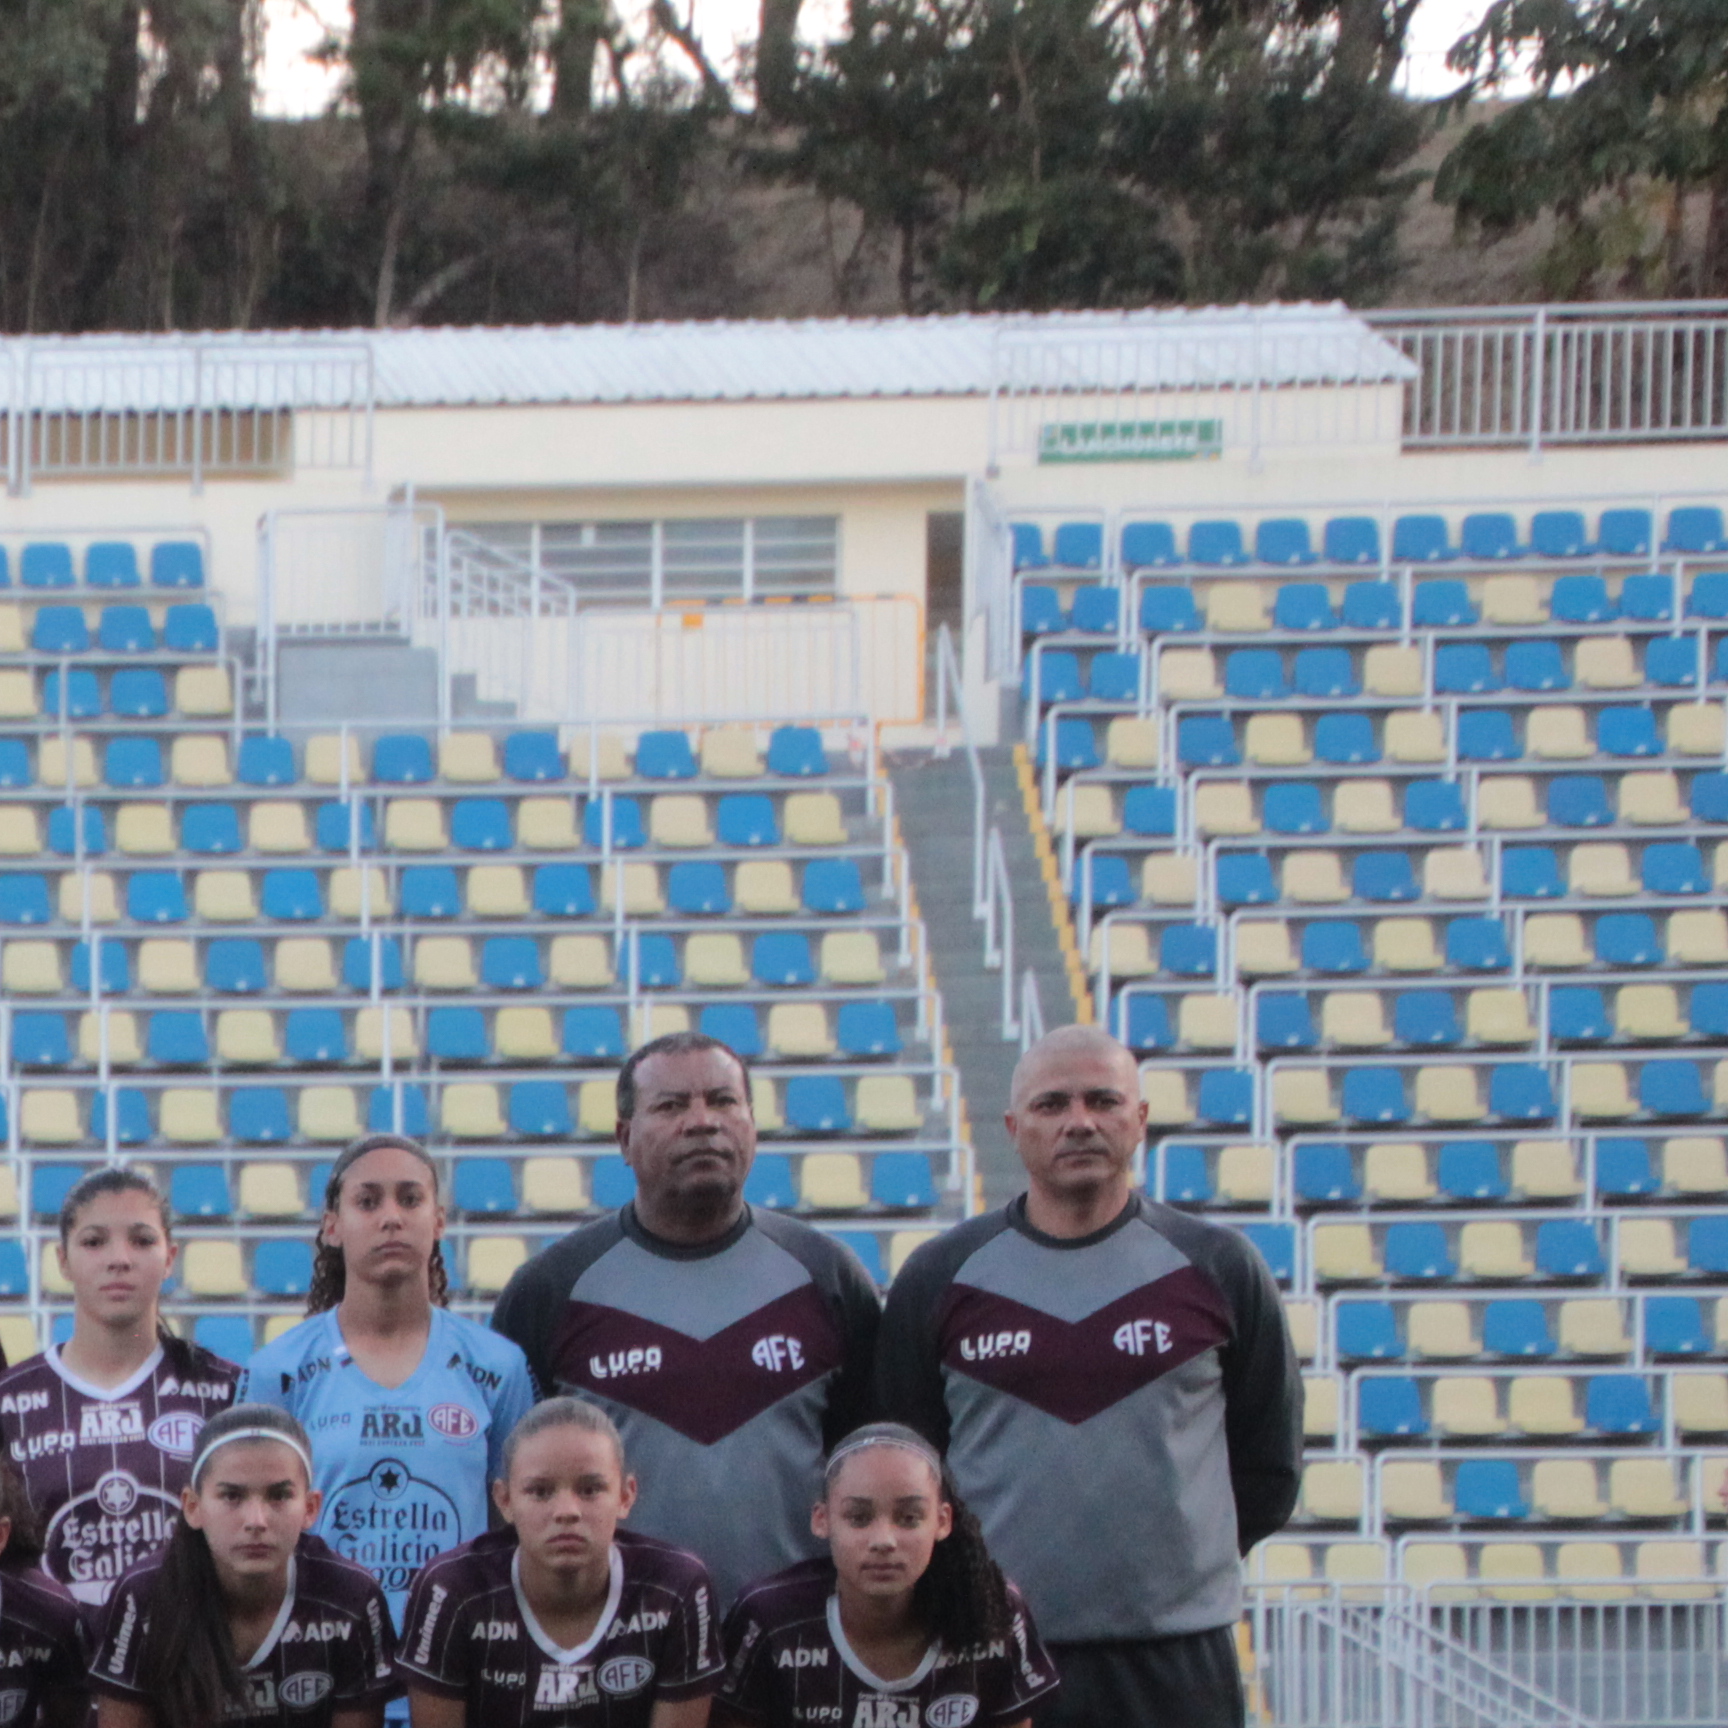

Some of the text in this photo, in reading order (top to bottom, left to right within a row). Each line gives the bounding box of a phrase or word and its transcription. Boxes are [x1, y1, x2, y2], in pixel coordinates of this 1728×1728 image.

[960, 1331, 1032, 1358] LUPO
[1114, 1320, 1173, 1354] AFE
[589, 1346, 663, 1377] LUPO
[1, 1392, 48, 1414] ADN
[181, 1380, 228, 1400] ADN
[80, 1409, 143, 1438] ARJ
[361, 1413, 424, 1438] ARJ
[431, 1408, 475, 1434] AFE
[11, 1432, 75, 1461] LUPO
[331, 1502, 447, 1533] Estrella
[337, 1533, 440, 1566] Galicia
[306, 1621, 351, 1641] ADN
[472, 1622, 518, 1640] ADN
[626, 1611, 671, 1634] ADN
[779, 1648, 828, 1668] ADN
[537, 1672, 597, 1703] ARJ
